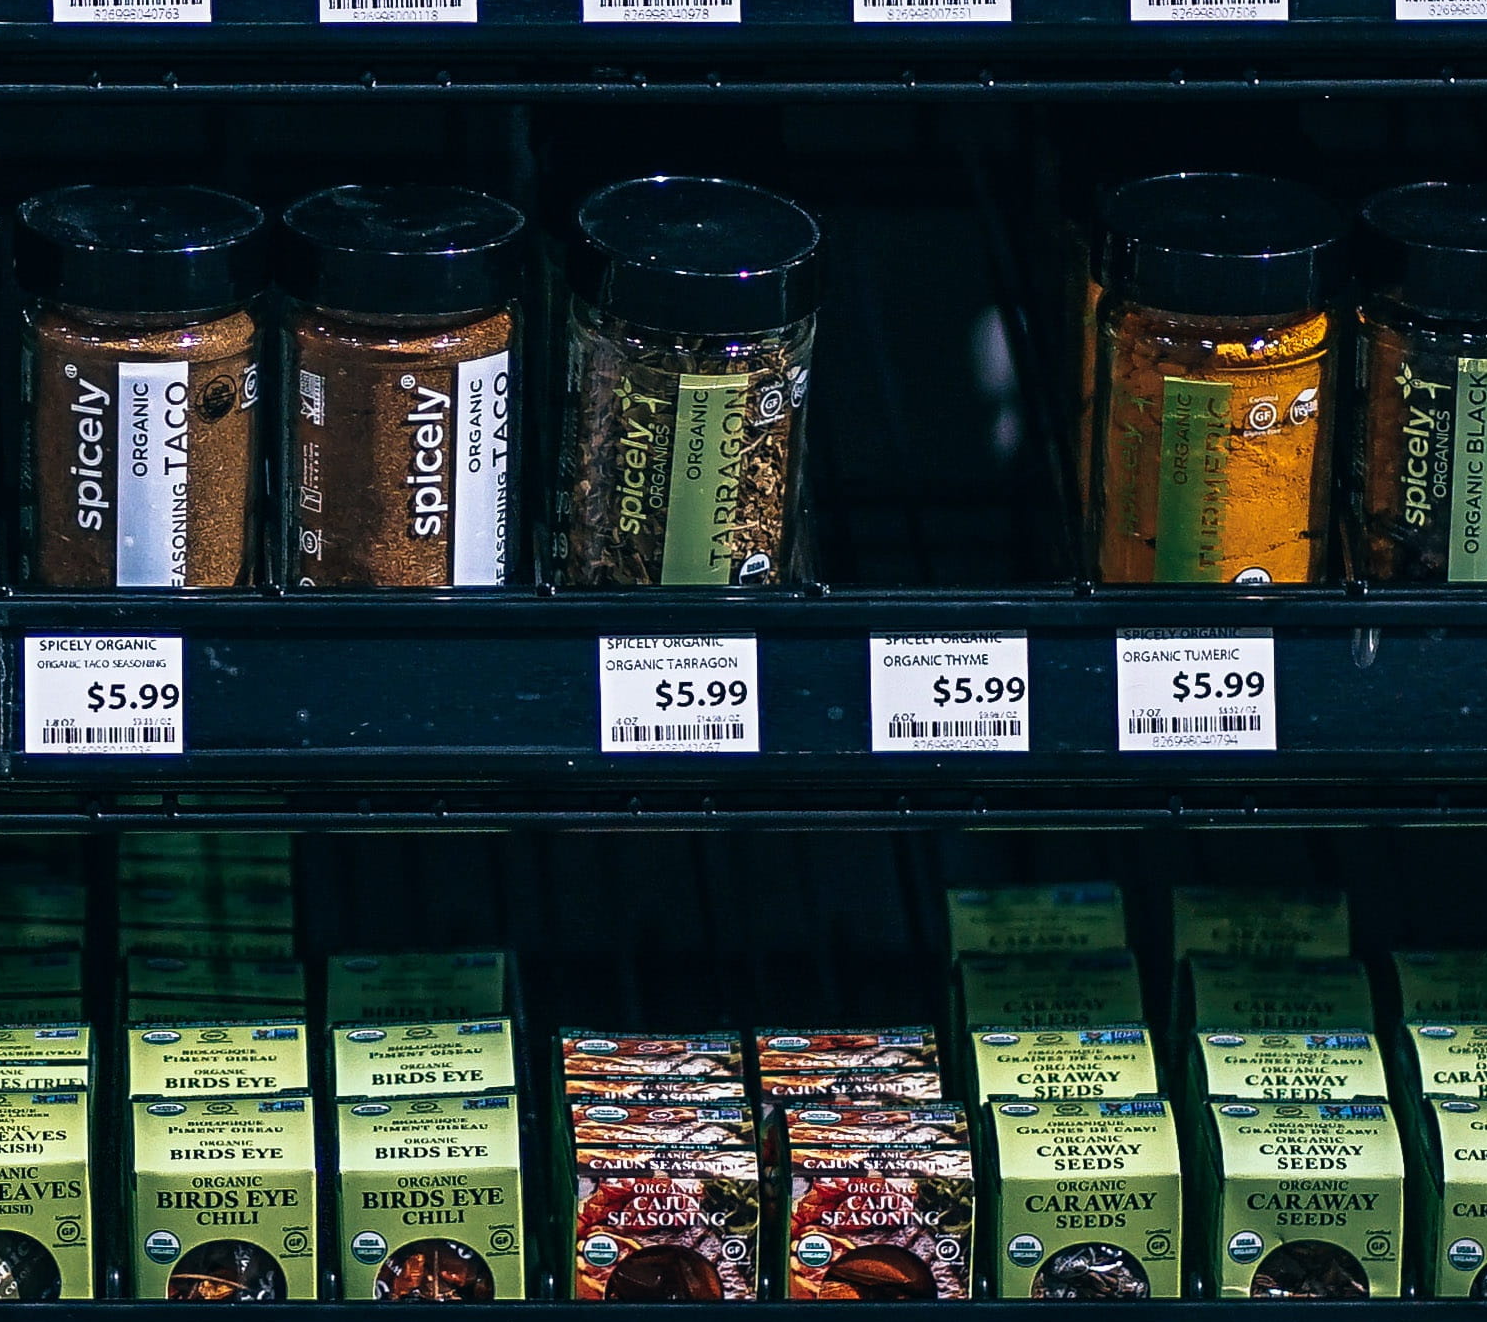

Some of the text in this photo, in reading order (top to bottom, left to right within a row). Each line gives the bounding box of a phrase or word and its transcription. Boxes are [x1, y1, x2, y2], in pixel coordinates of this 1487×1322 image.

[162, 380, 190, 477] TACO
[1434, 409, 1450, 498] ORGANICS
[709, 387, 749, 569] TARRAGON
[156, 1189, 298, 1209] BIRDS EYE
[1025, 1193, 1157, 1213] CARAWAY
